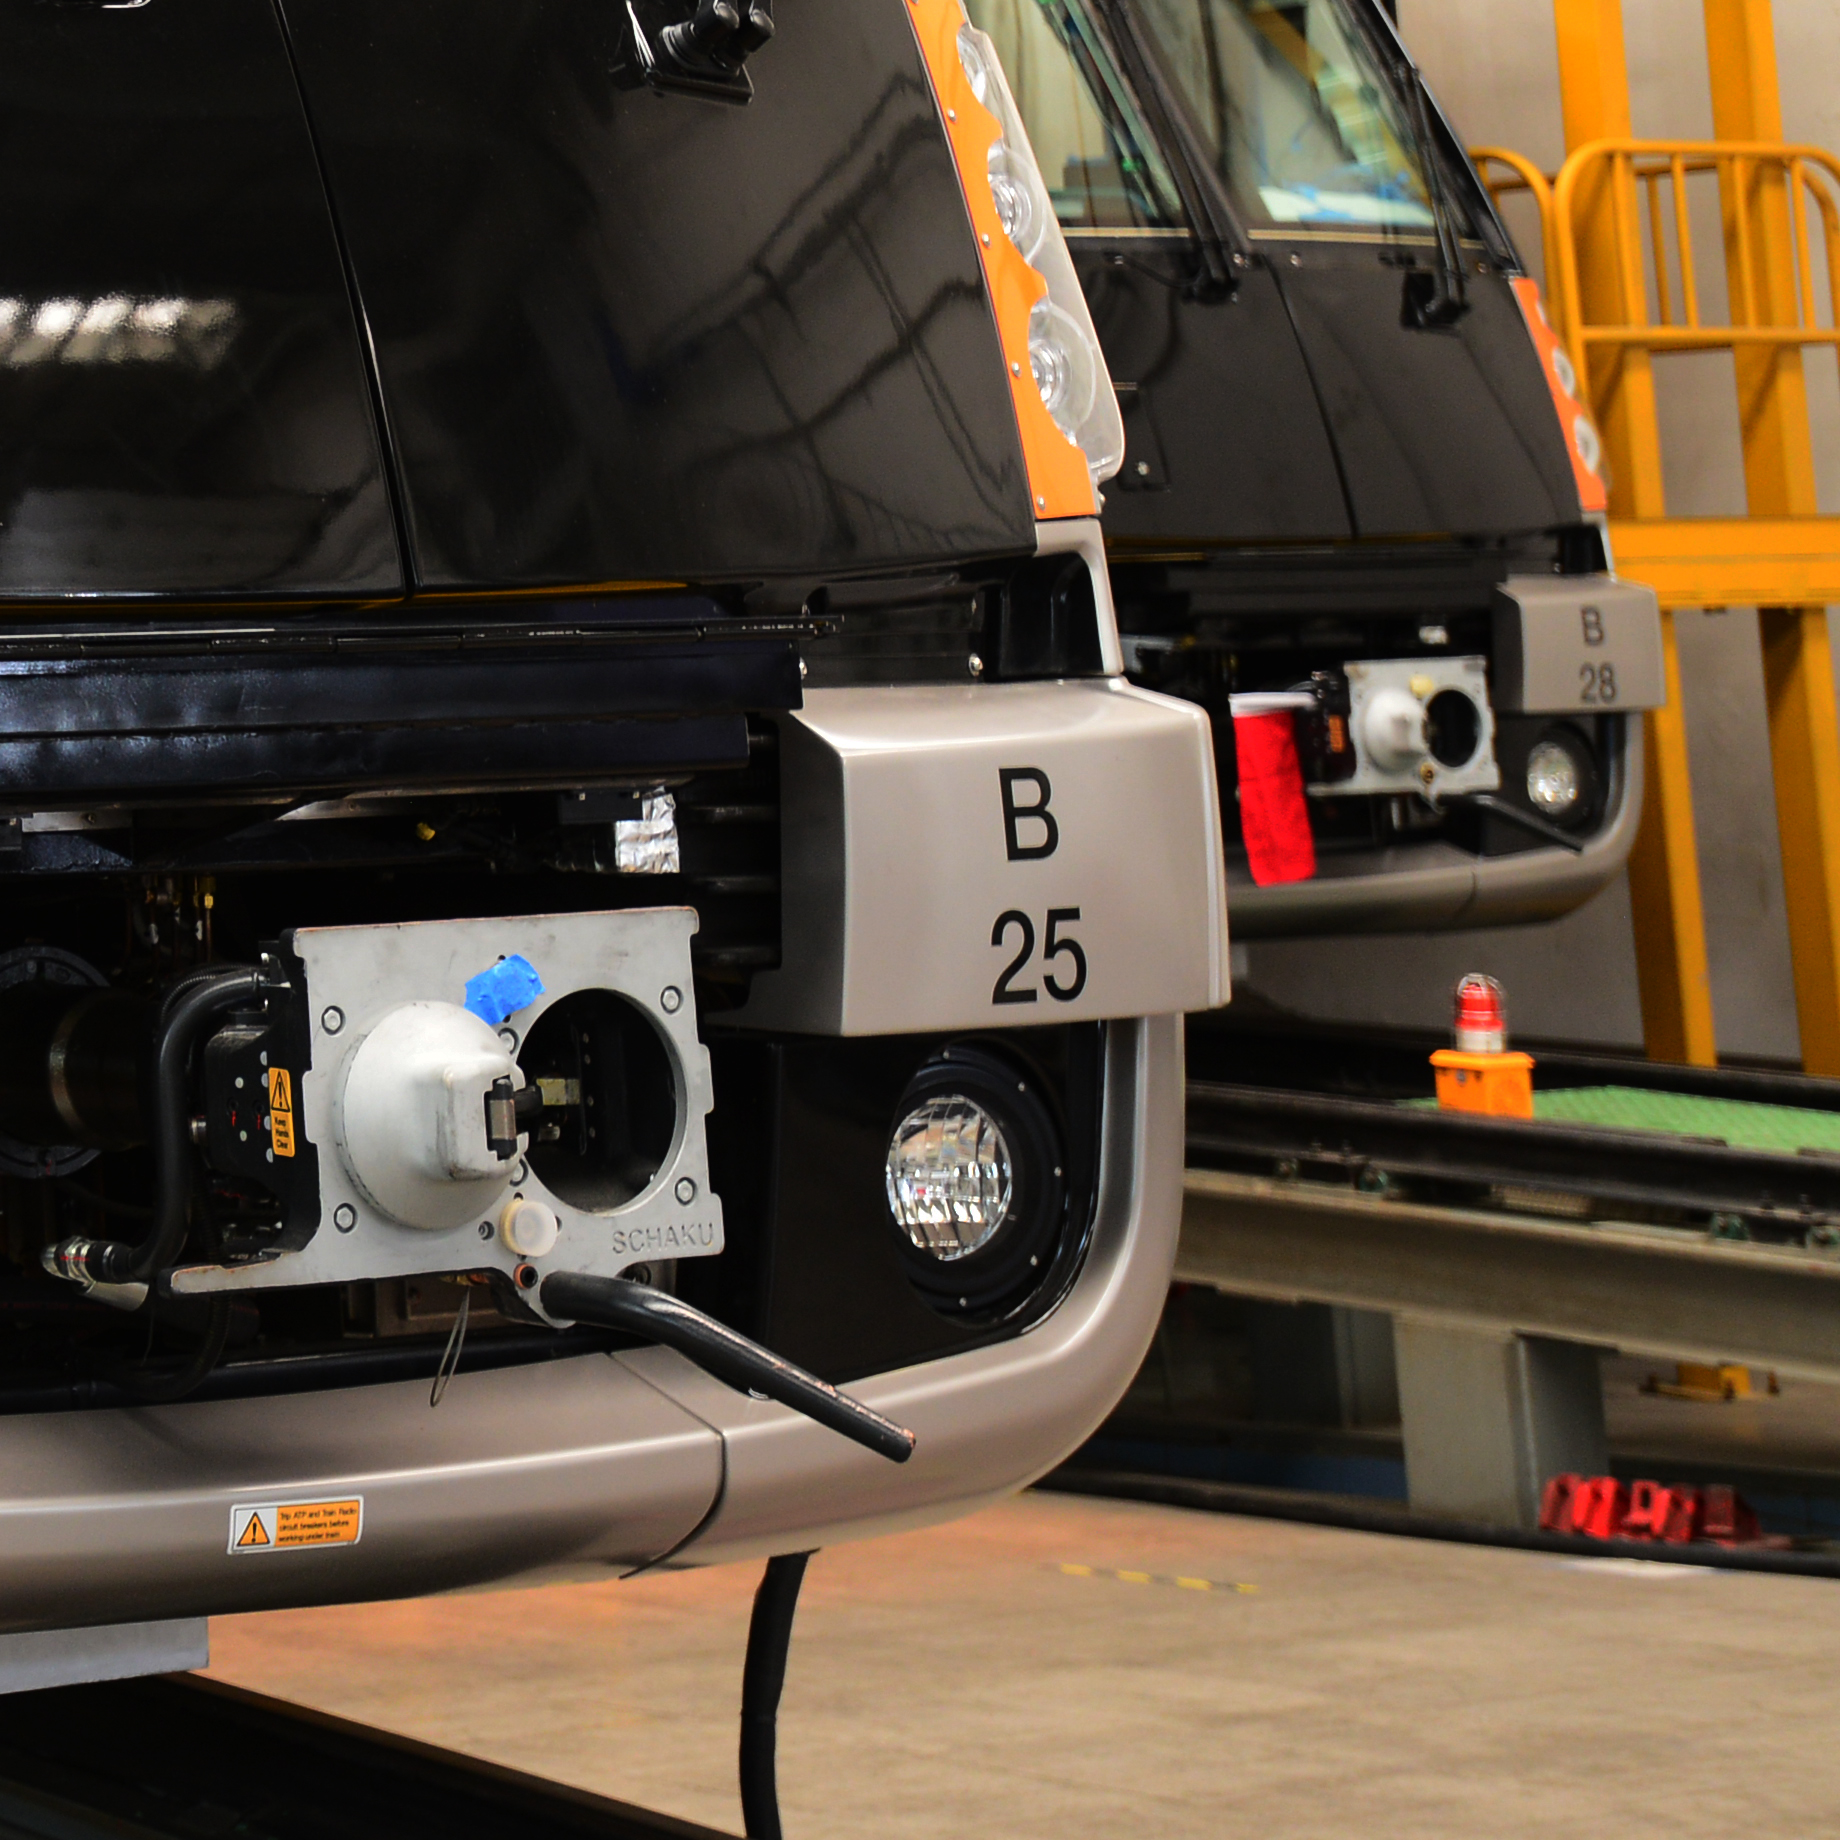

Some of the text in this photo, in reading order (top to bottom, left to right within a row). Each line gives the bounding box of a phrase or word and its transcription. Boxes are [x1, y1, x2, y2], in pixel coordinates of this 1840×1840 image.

[1581, 606, 1604, 646] B
[1580, 662, 1616, 703] 28
[998, 767, 1059, 861] B
[991, 906, 1088, 1005] 25
[612, 1222, 713, 1254] SCHAKU
